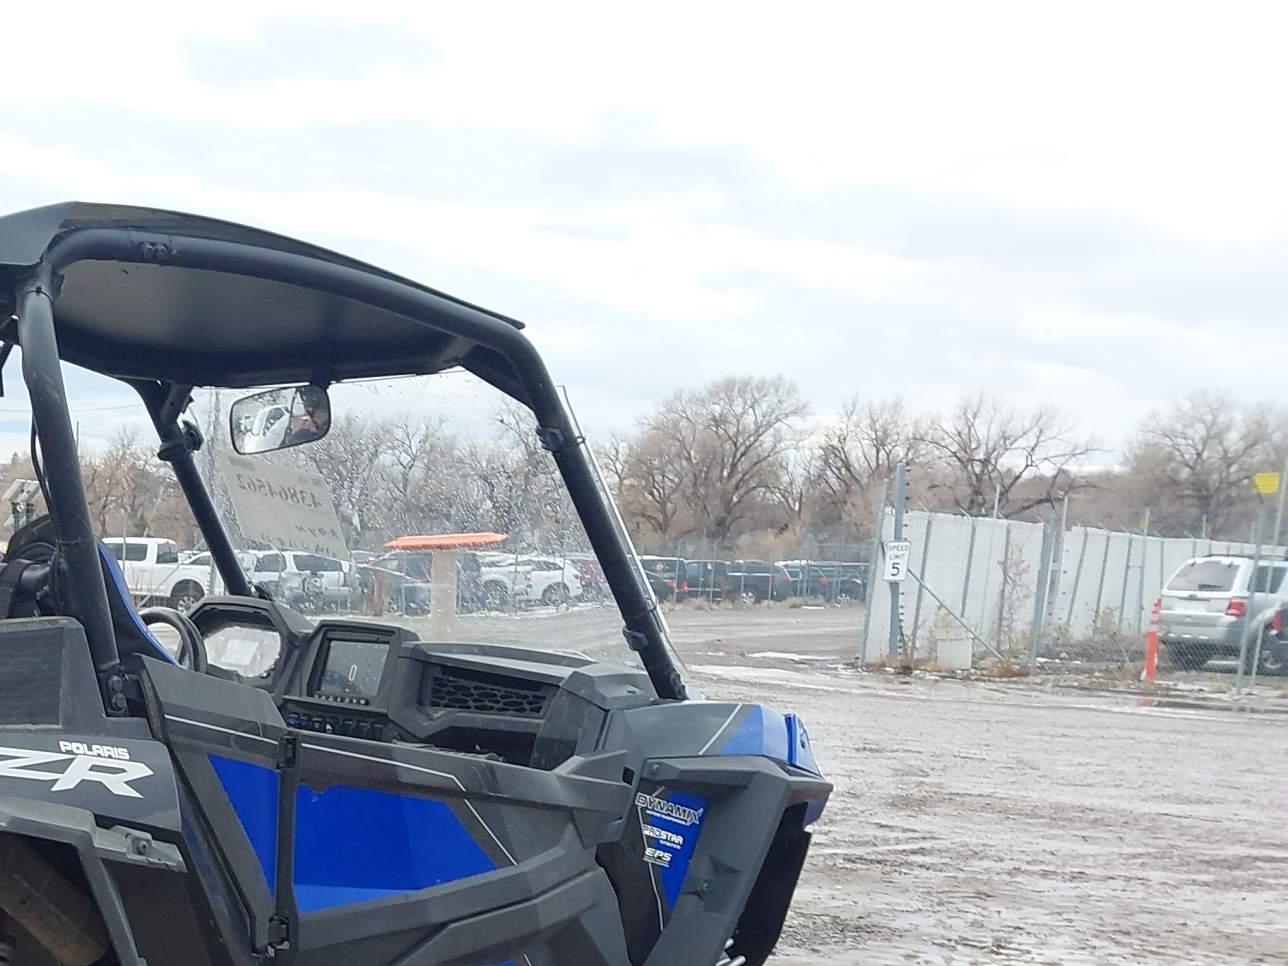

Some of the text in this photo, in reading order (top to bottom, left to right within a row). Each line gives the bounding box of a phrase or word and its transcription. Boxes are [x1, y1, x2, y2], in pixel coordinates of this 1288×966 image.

[890, 562, 900, 577] 5
[59, 740, 130, 760] POLARIS
[635, 792, 703, 825] DYNAMIX
[645, 847, 672, 862] EPS
